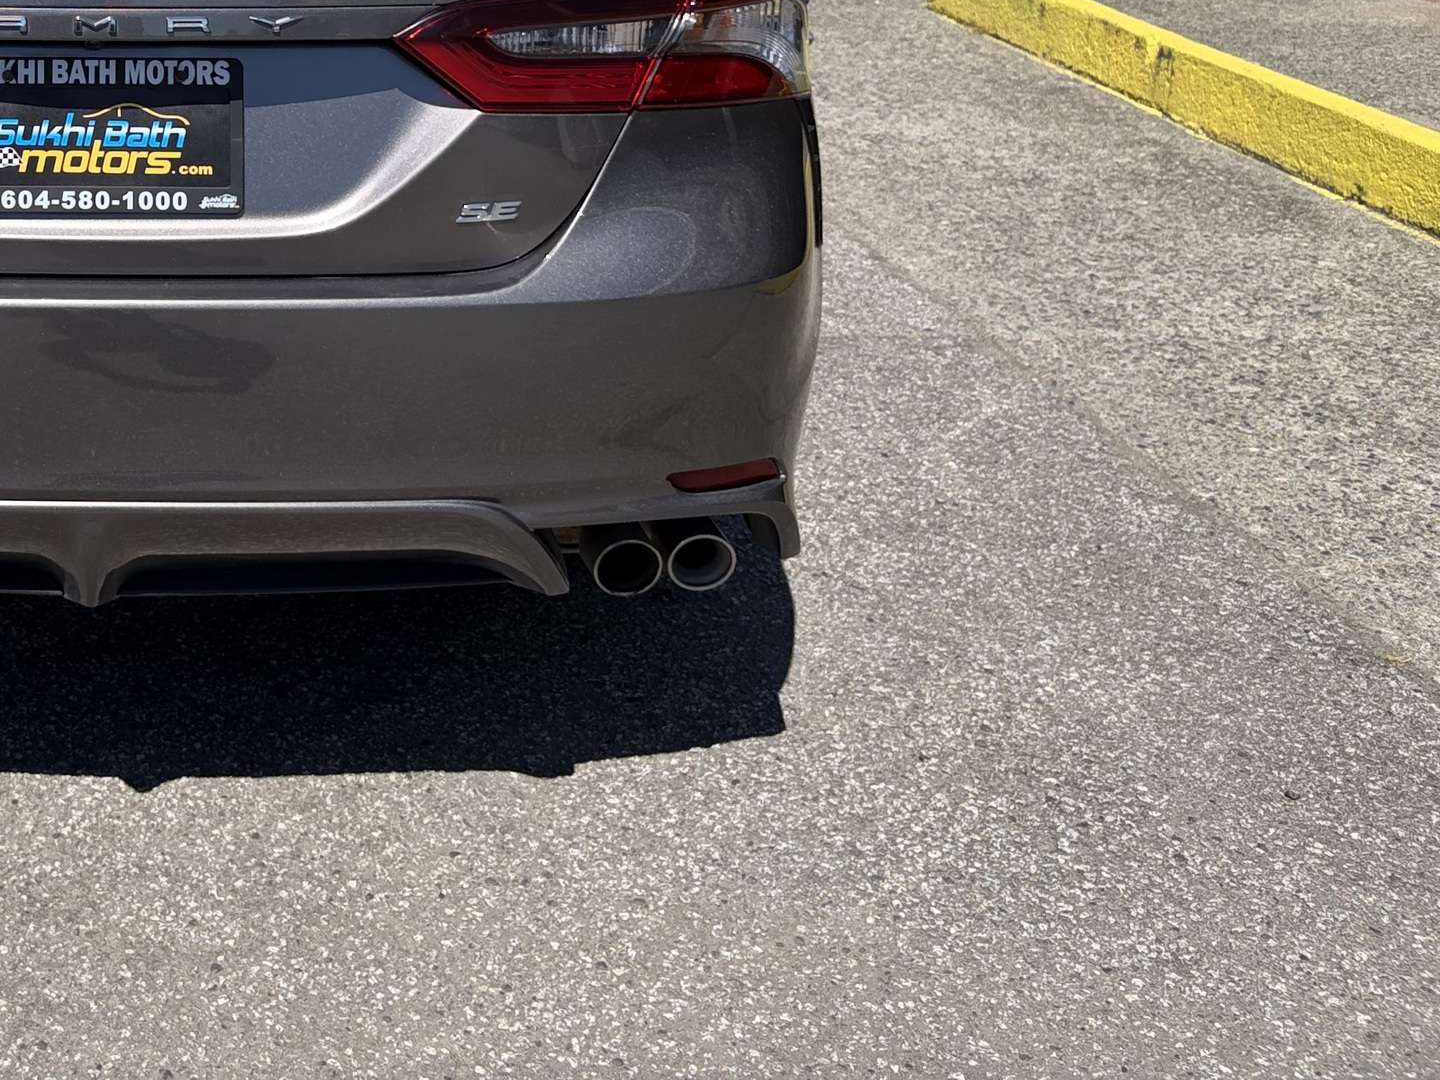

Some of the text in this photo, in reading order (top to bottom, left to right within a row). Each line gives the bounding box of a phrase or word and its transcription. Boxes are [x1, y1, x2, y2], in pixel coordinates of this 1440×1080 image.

[51, 59, 116, 85] BATH
[124, 59, 231, 86] MOTORS
[103, 119, 188, 148] Bath
[0, 189, 188, 211] 604-580-1000
[456, 201, 522, 223] SE
